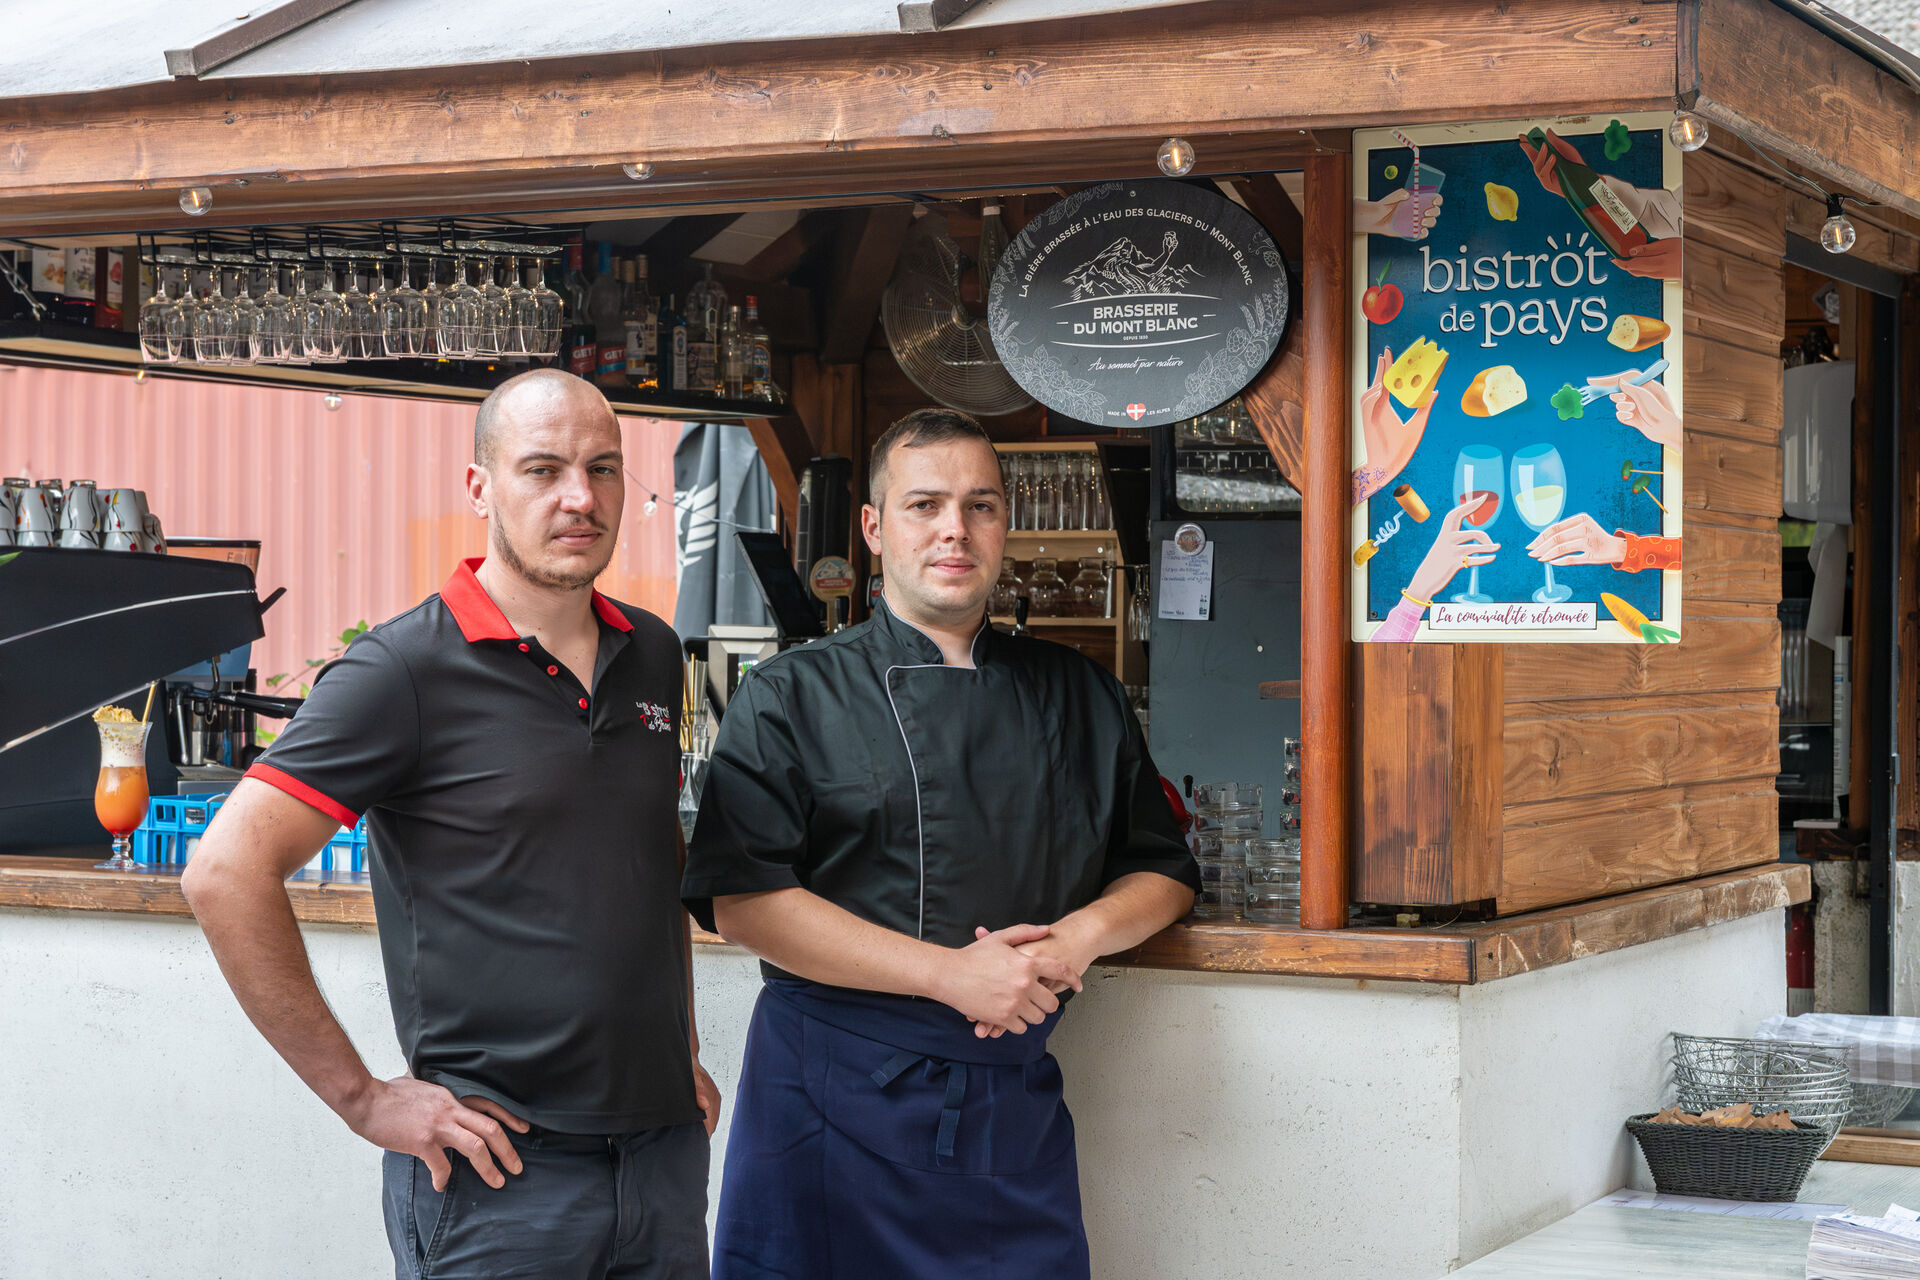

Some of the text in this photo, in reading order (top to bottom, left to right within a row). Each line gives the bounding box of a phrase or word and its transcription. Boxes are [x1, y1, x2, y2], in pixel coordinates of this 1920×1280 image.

[1018, 208, 1253, 298] LA BIÈRE BRASSÉE À L'EAU DES GLACIERS DU MONT BLANC
[1093, 302, 1179, 320] BRASSERIE
[1073, 316, 1199, 335] DU MONT BLANC
[1439, 295, 1609, 348] de pays
[1087, 354, 1185, 374] Au sommet par nature
[1436, 604, 1590, 625] La convivialité retrouvée
